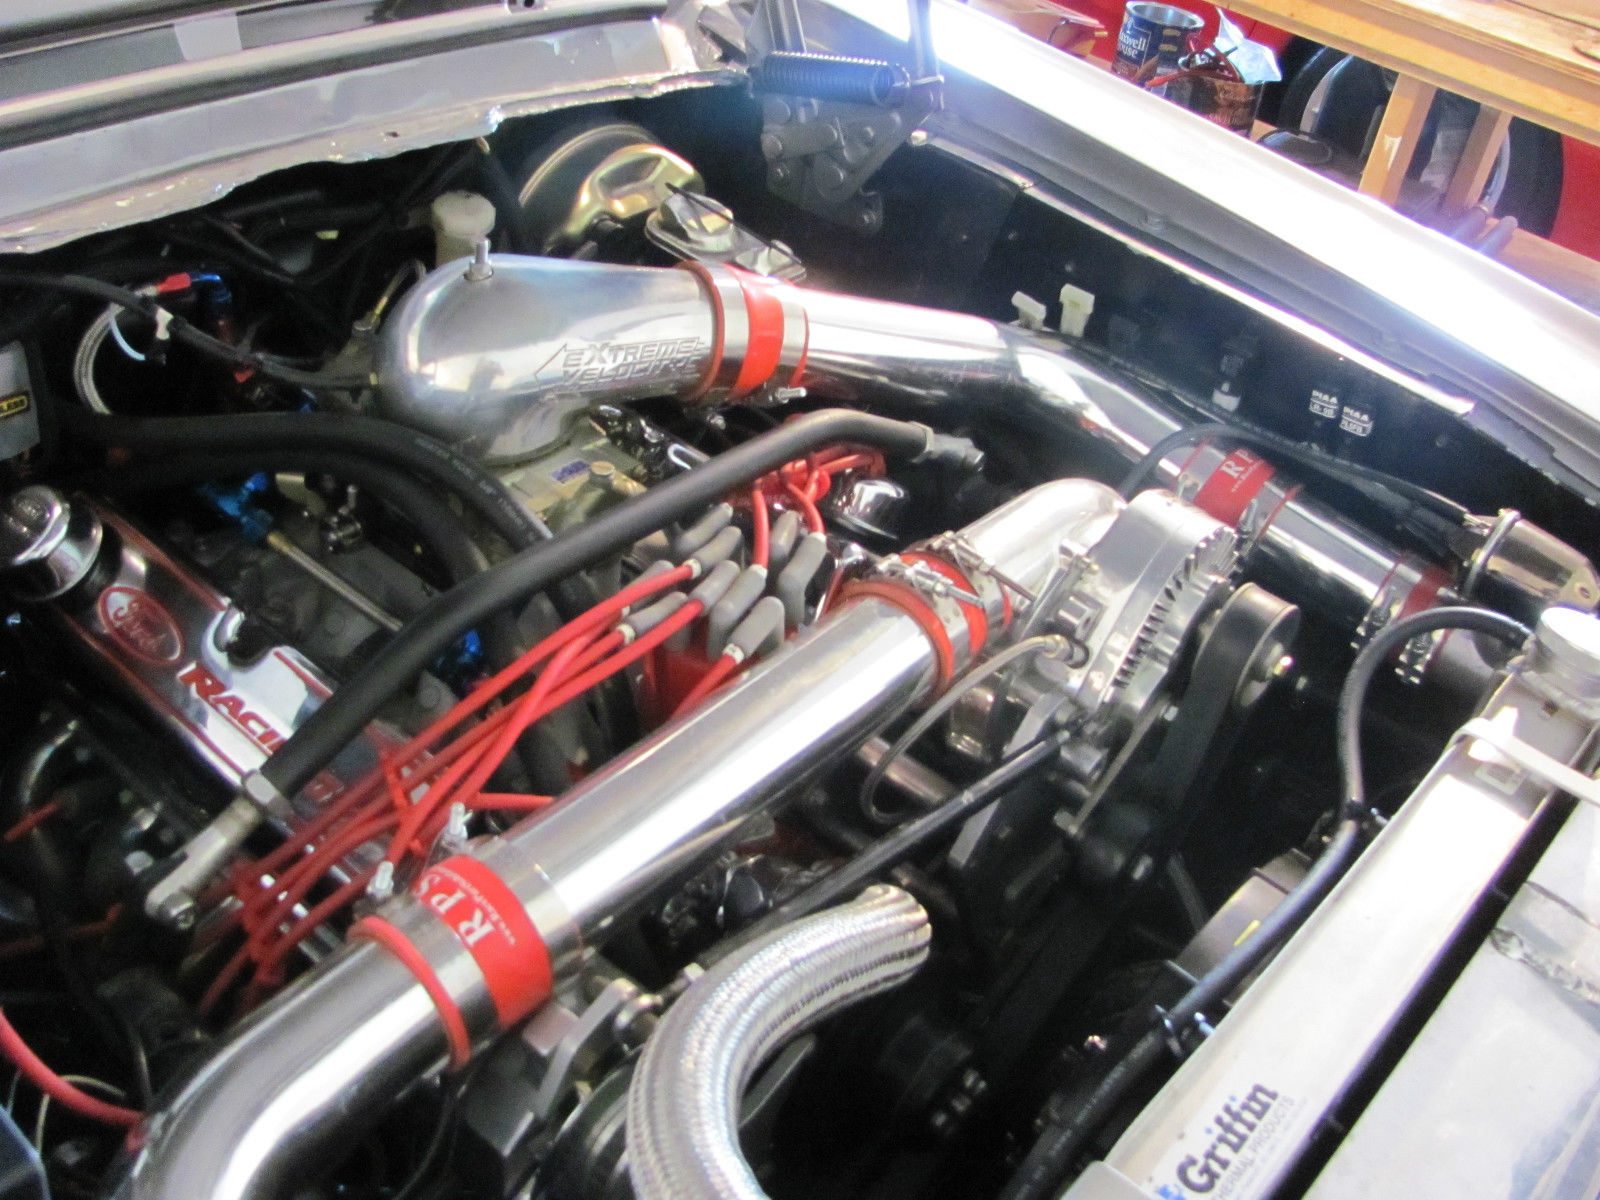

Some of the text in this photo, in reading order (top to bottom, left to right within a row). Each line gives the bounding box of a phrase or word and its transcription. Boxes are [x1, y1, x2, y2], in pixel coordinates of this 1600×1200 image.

[1119, 32, 1147, 51] axwell
[562, 338, 698, 368] EXTREME
[1177, 1083, 1278, 1192] Griffin
